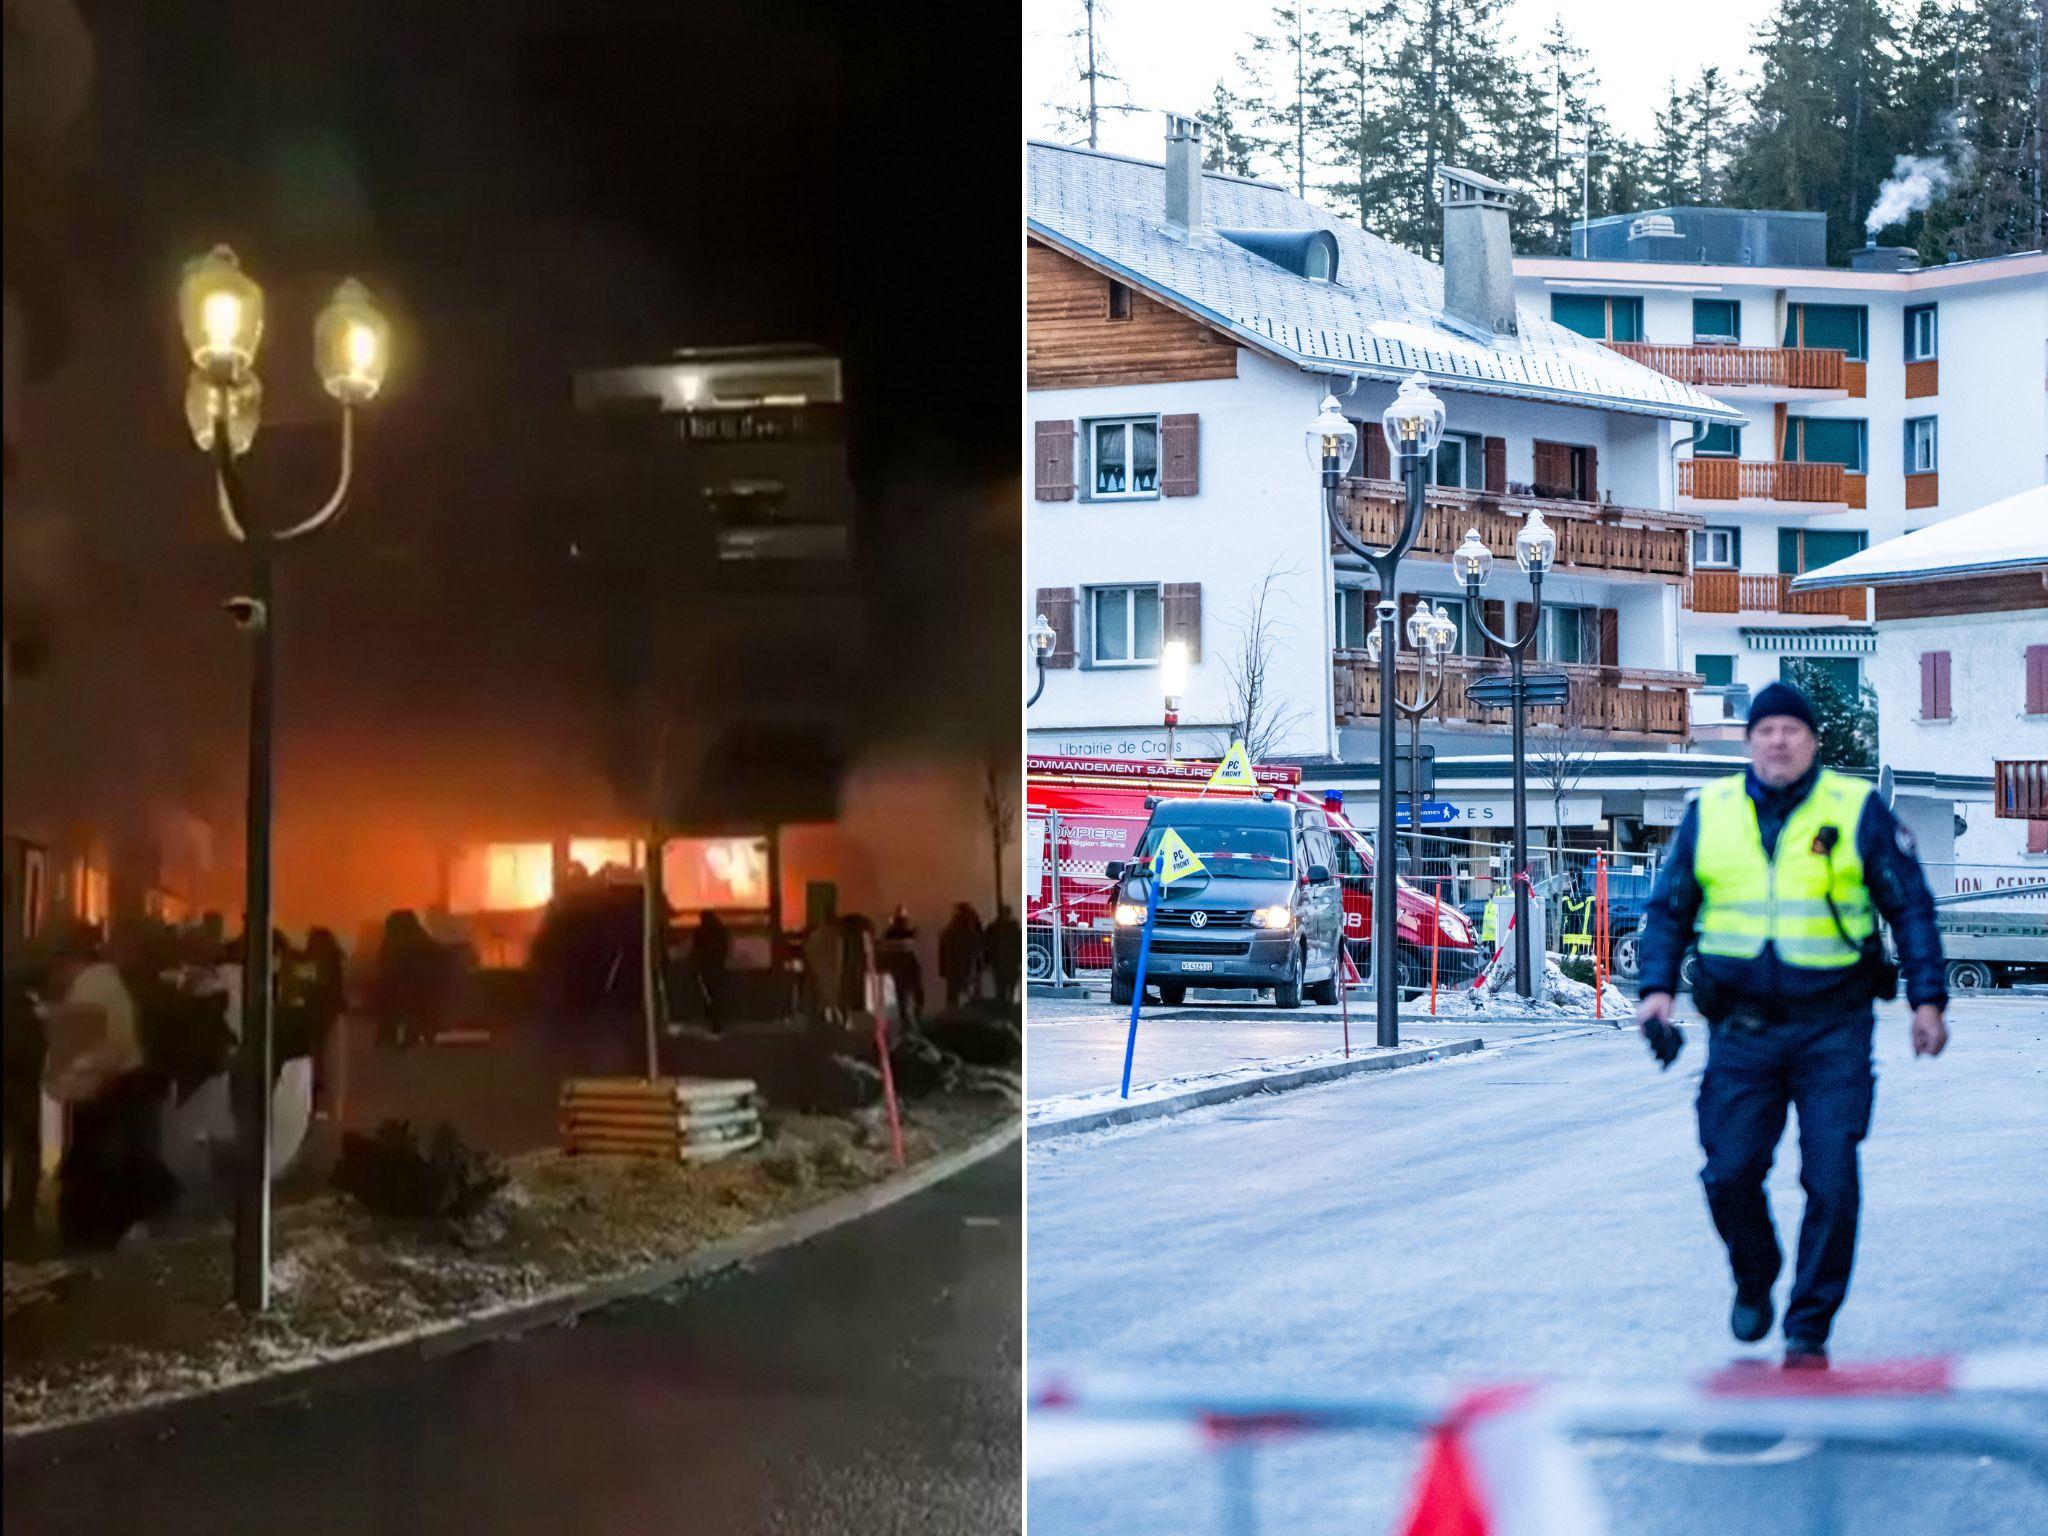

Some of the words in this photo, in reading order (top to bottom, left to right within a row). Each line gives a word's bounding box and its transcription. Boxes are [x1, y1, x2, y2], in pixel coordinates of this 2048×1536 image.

[1059, 743, 1112, 755] Librairie
[1118, 743, 1136, 753] de
[1141, 740, 1181, 753] Cras
[1227, 760, 1239, 770] PC
[1221, 770, 1241, 778] FRONT
[1173, 849, 1184, 861] PC
[1173, 859, 1190, 870] FRONT
